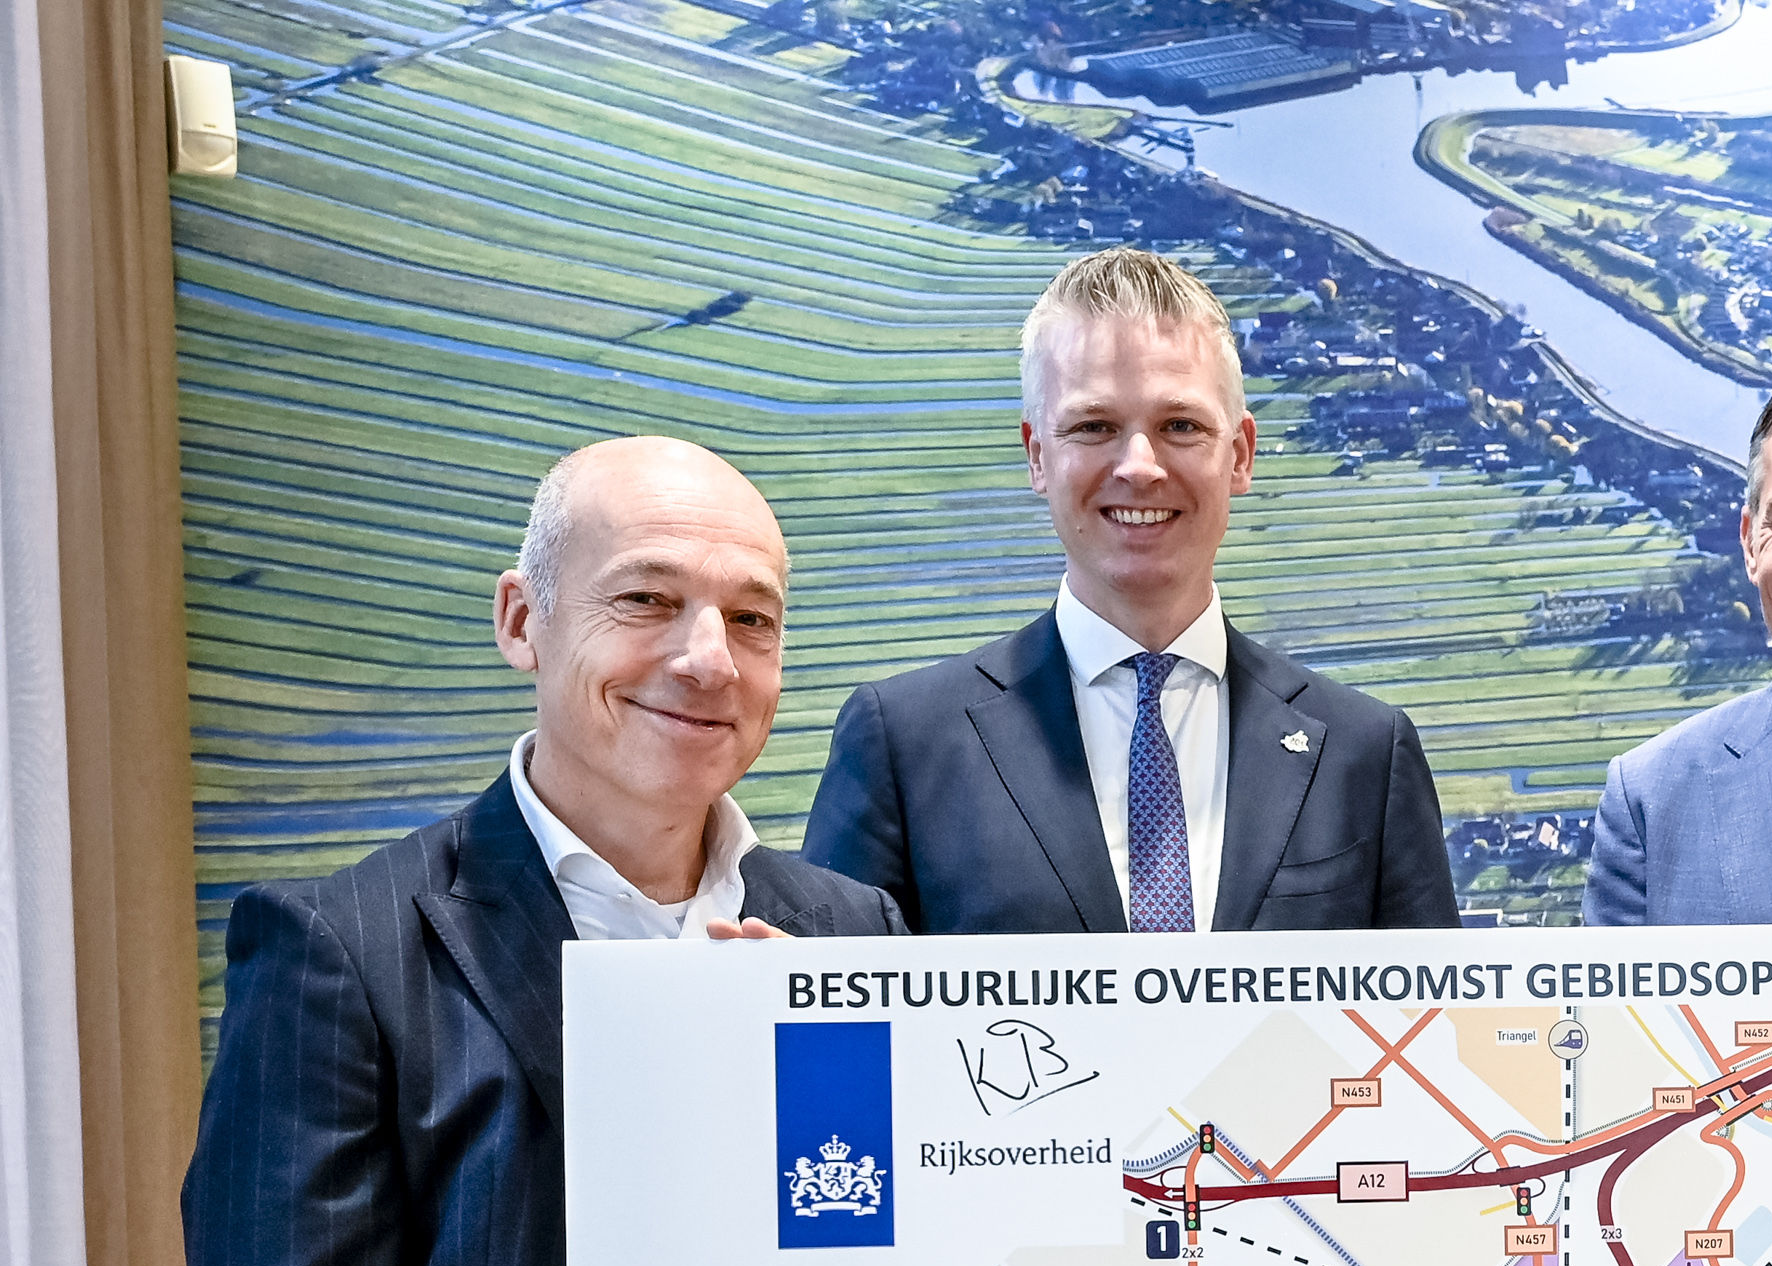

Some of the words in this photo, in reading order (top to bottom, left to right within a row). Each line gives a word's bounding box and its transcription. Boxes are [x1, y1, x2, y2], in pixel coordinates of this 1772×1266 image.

[787, 968, 1118, 1009] BESTUURLIJKE
[1133, 963, 1513, 1006] OVEREENKOMST
[1497, 1029, 1537, 1044] Triangel
[1743, 1028, 1769, 1039] N452
[1341, 1086, 1373, 1098] N453
[1661, 1093, 1686, 1105] N451
[919, 1137, 1112, 1175] Rijksoverheid
[1357, 1173, 1386, 1189] A12
[1156, 1225, 1170, 1253] 1
[1515, 1233, 1546, 1246] N457
[1601, 1227, 1623, 1241] 2x3
[1694, 1237, 1724, 1250] N207
[1181, 1246, 1204, 1259] 2x2
